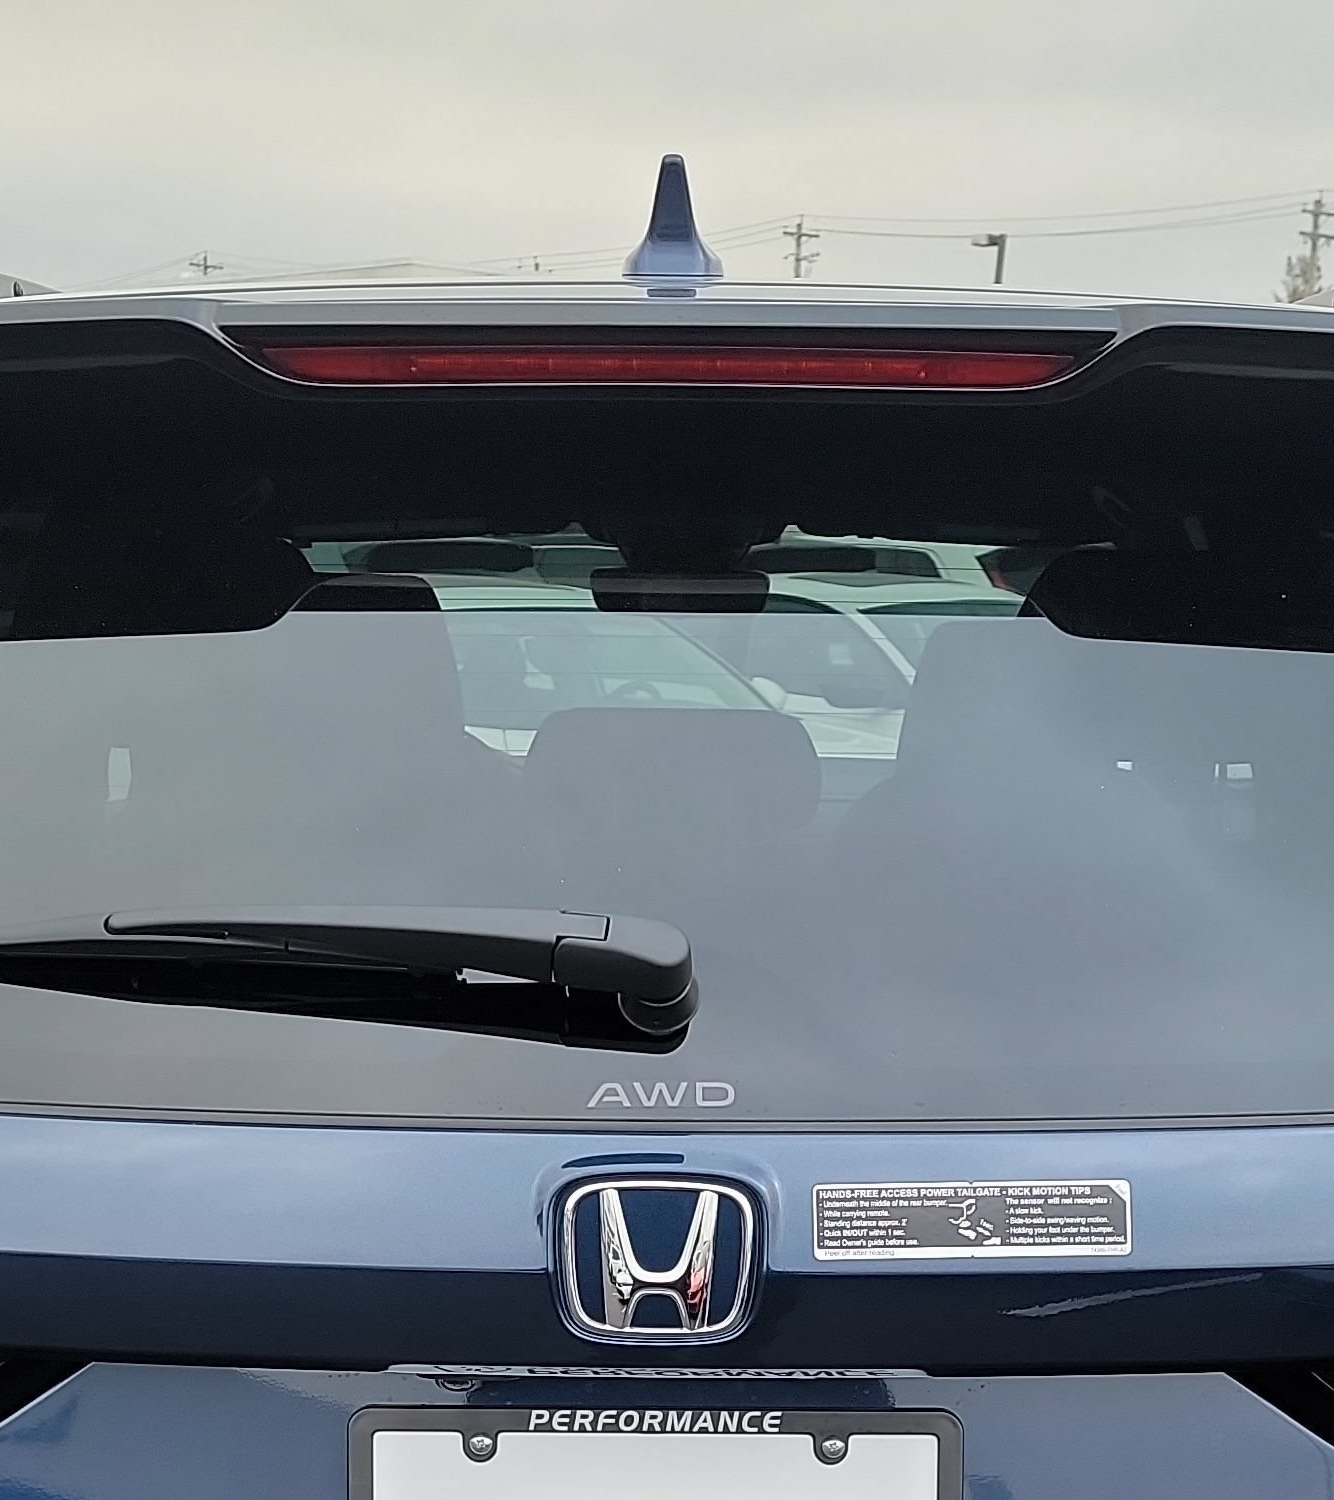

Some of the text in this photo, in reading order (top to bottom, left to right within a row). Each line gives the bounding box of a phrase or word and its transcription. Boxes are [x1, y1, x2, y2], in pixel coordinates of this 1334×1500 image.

[587, 1081, 736, 1108] AWD
[819, 1189, 880, 1199] HANDS-FREE
[880, 1189, 918, 1198] ACCESS
[920, 1188, 955, 1197] POWER
[956, 1187, 1001, 1197] TAILGATE
[1008, 1187, 1031, 1196] KICK
[1032, 1187, 1069, 1196] MOTION
[1069, 1186, 1091, 1195] TIPS
[823, 1200, 859, 1208] Underneath
[870, 1199, 890, 1207] middle
[891, 1199, 899, 1207] of
[1047, 1197, 1060, 1205] will
[1074, 1197, 1108, 1206] recognize
[823, 1210, 841, 1218] While
[842, 1210, 866, 1218] carrying
[823, 1220, 851, 1228] Standing
[1010, 1217, 1046, 1225] Side-to-side
[842, 1229, 868, 1237] IN/OUT
[1010, 1227, 1033, 1235] Holding
[1034, 1227, 1048, 1235] your
[824, 1239, 840, 1247] Read
[867, 1239, 885, 1247] guide
[885, 1238, 905, 1246] before
[1010, 1236, 1034, 1244] Multiple
[1075, 1235, 1091, 1243] short
[1091, 1235, 1104, 1243] time
[528, 1409, 783, 1433] PERFORMANCE
